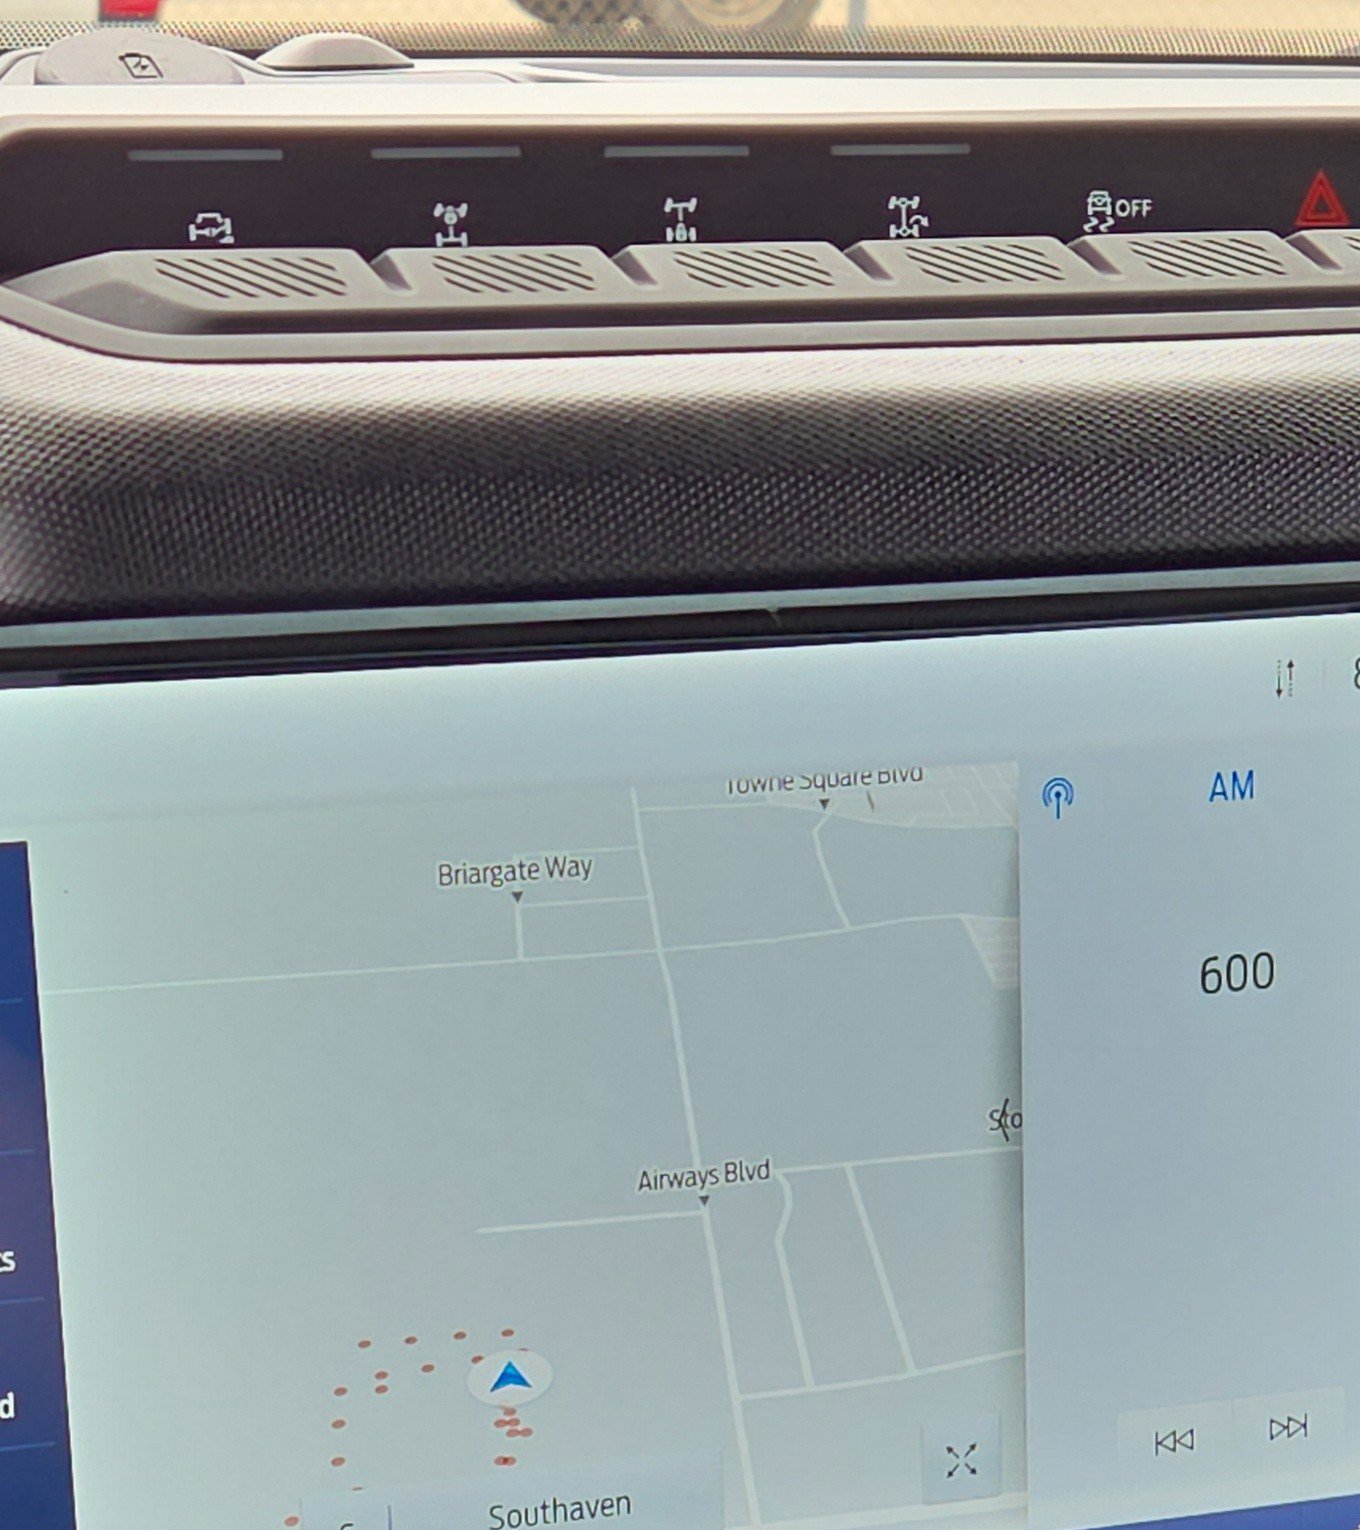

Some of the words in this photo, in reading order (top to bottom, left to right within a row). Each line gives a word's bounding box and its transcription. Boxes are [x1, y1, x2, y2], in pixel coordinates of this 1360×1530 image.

[1115, 198, 1153, 218] OFF
[1208, 769, 1254, 803] AM
[438, 860, 541, 888] Briargate
[544, 855, 594, 882] Way
[1200, 951, 1274, 995] 600
[638, 1165, 720, 1192] Airways
[724, 1158, 771, 1184] Blvd
